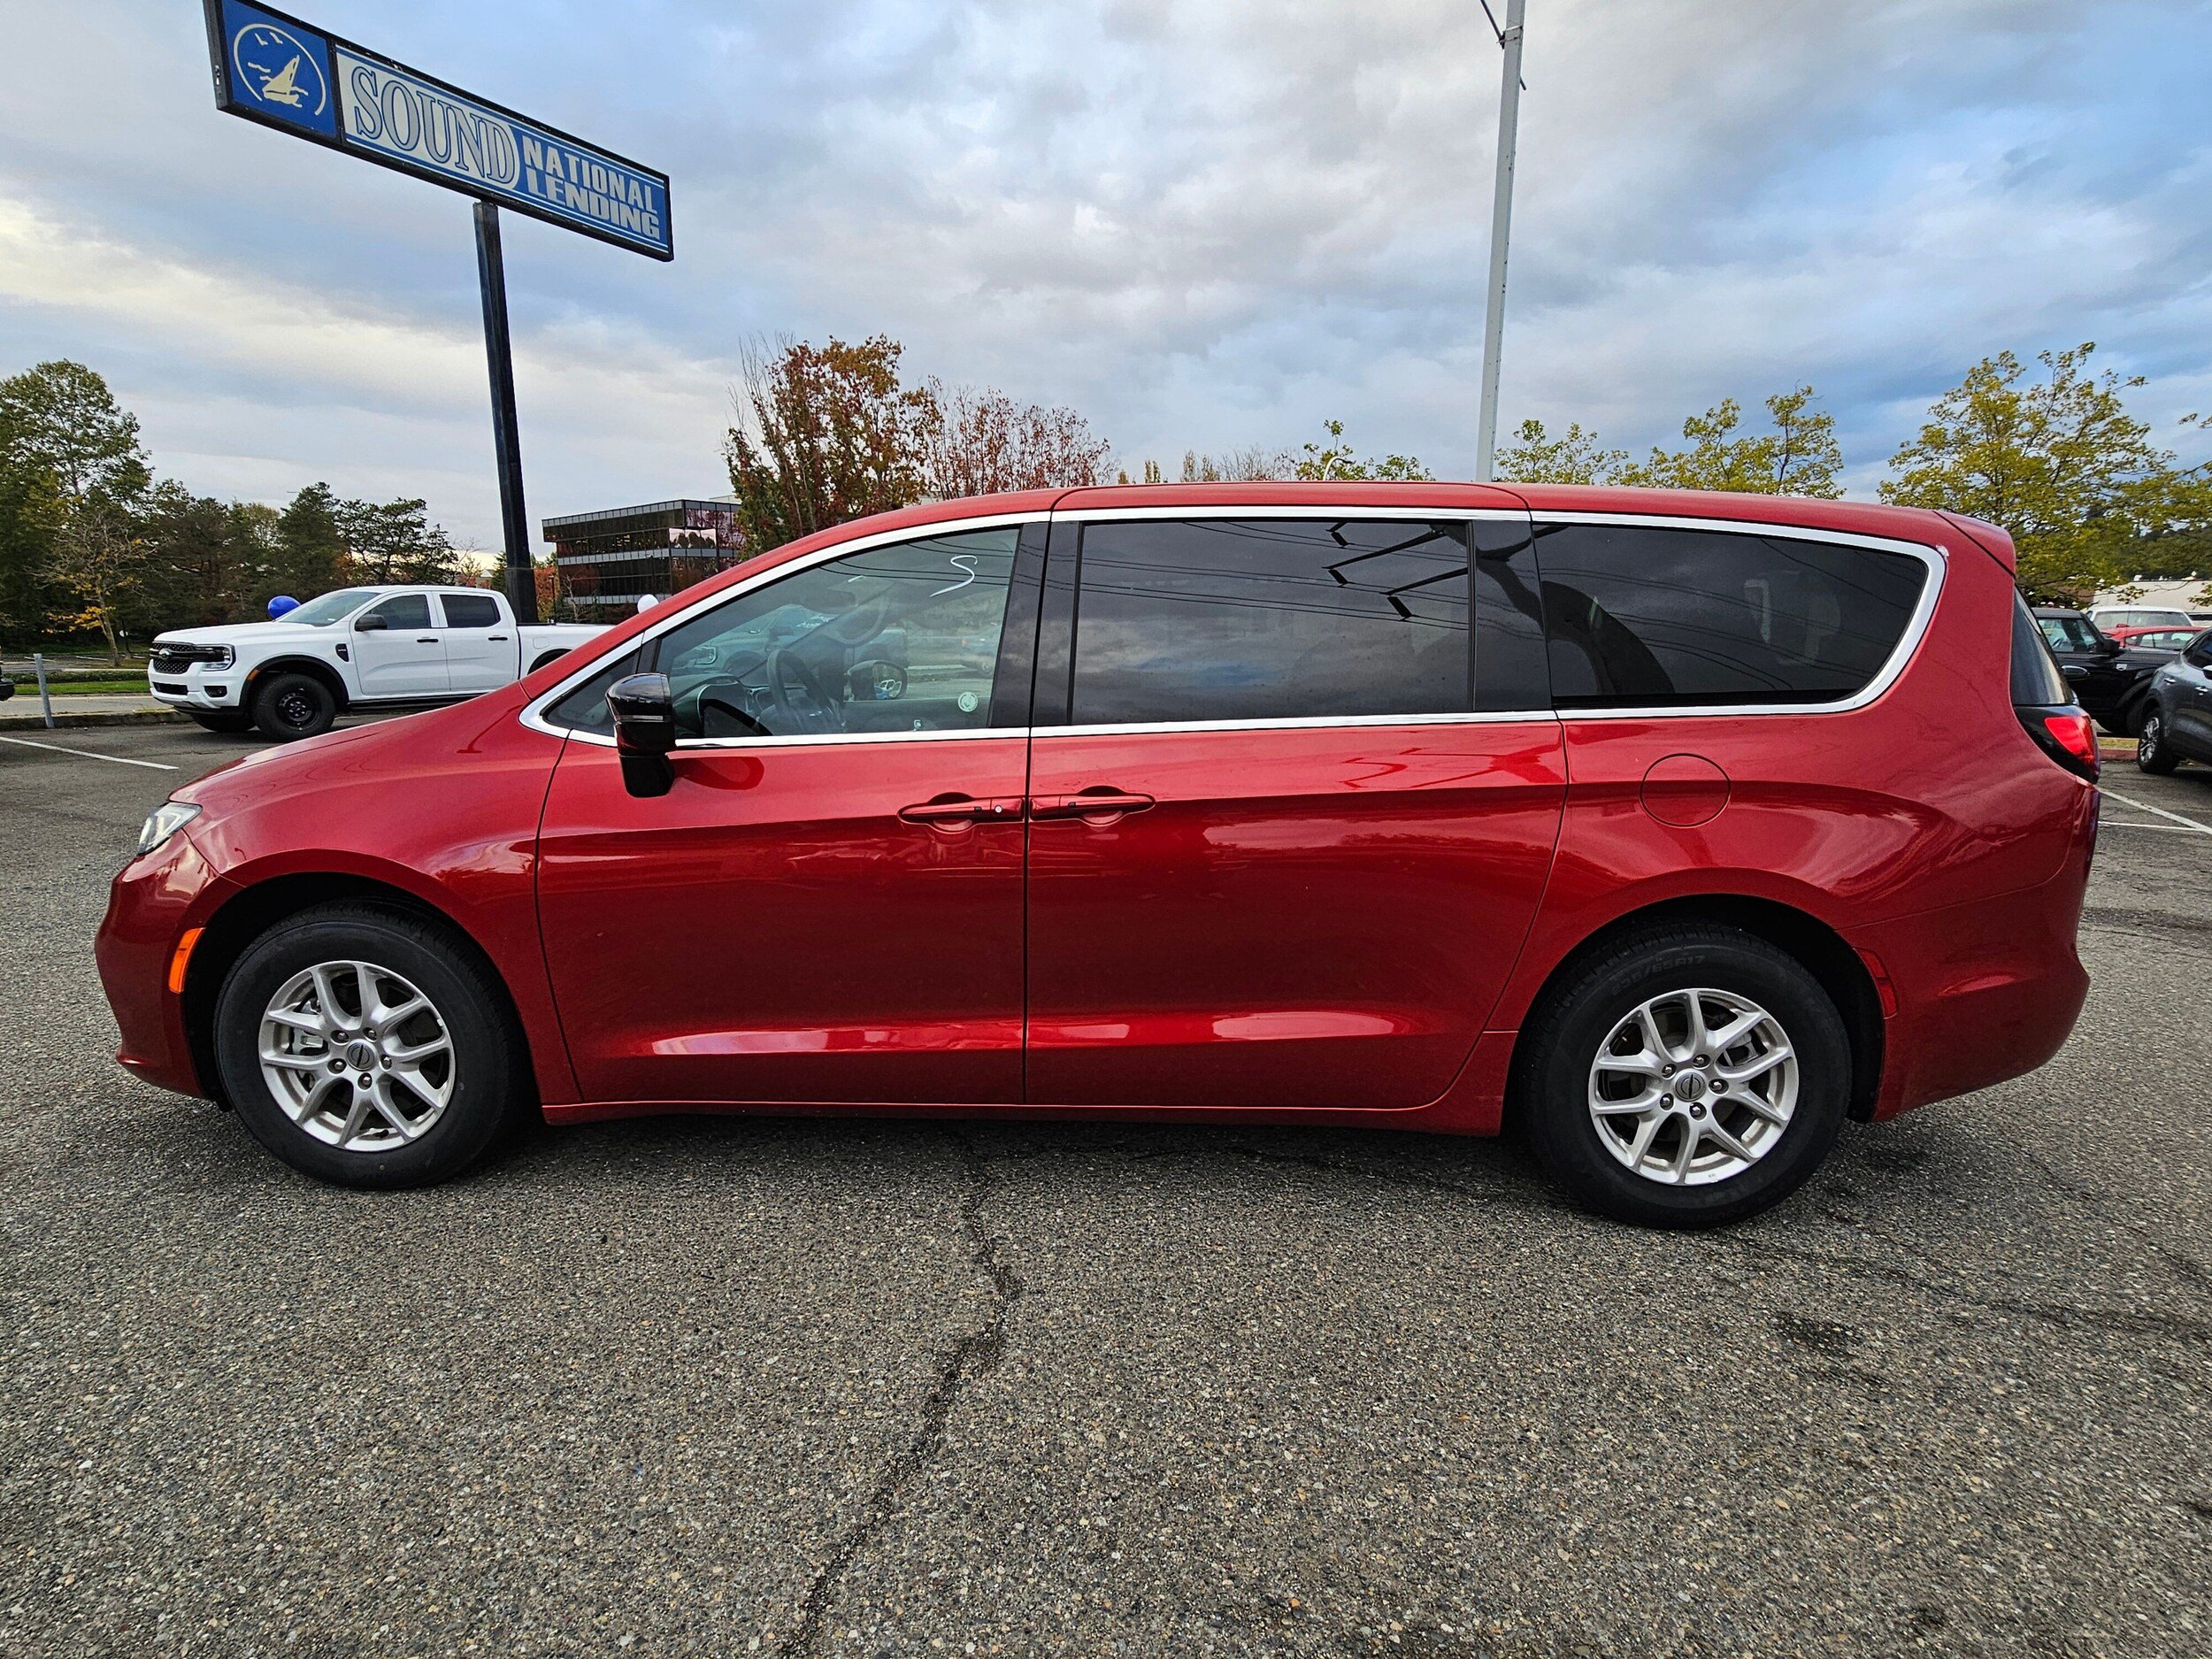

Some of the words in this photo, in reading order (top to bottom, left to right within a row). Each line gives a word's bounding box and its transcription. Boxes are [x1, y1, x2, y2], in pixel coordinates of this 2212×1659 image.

[351, 65, 515, 184] SOUND
[522, 135, 657, 214] NATIONAL
[526, 166, 660, 240] LENDING
